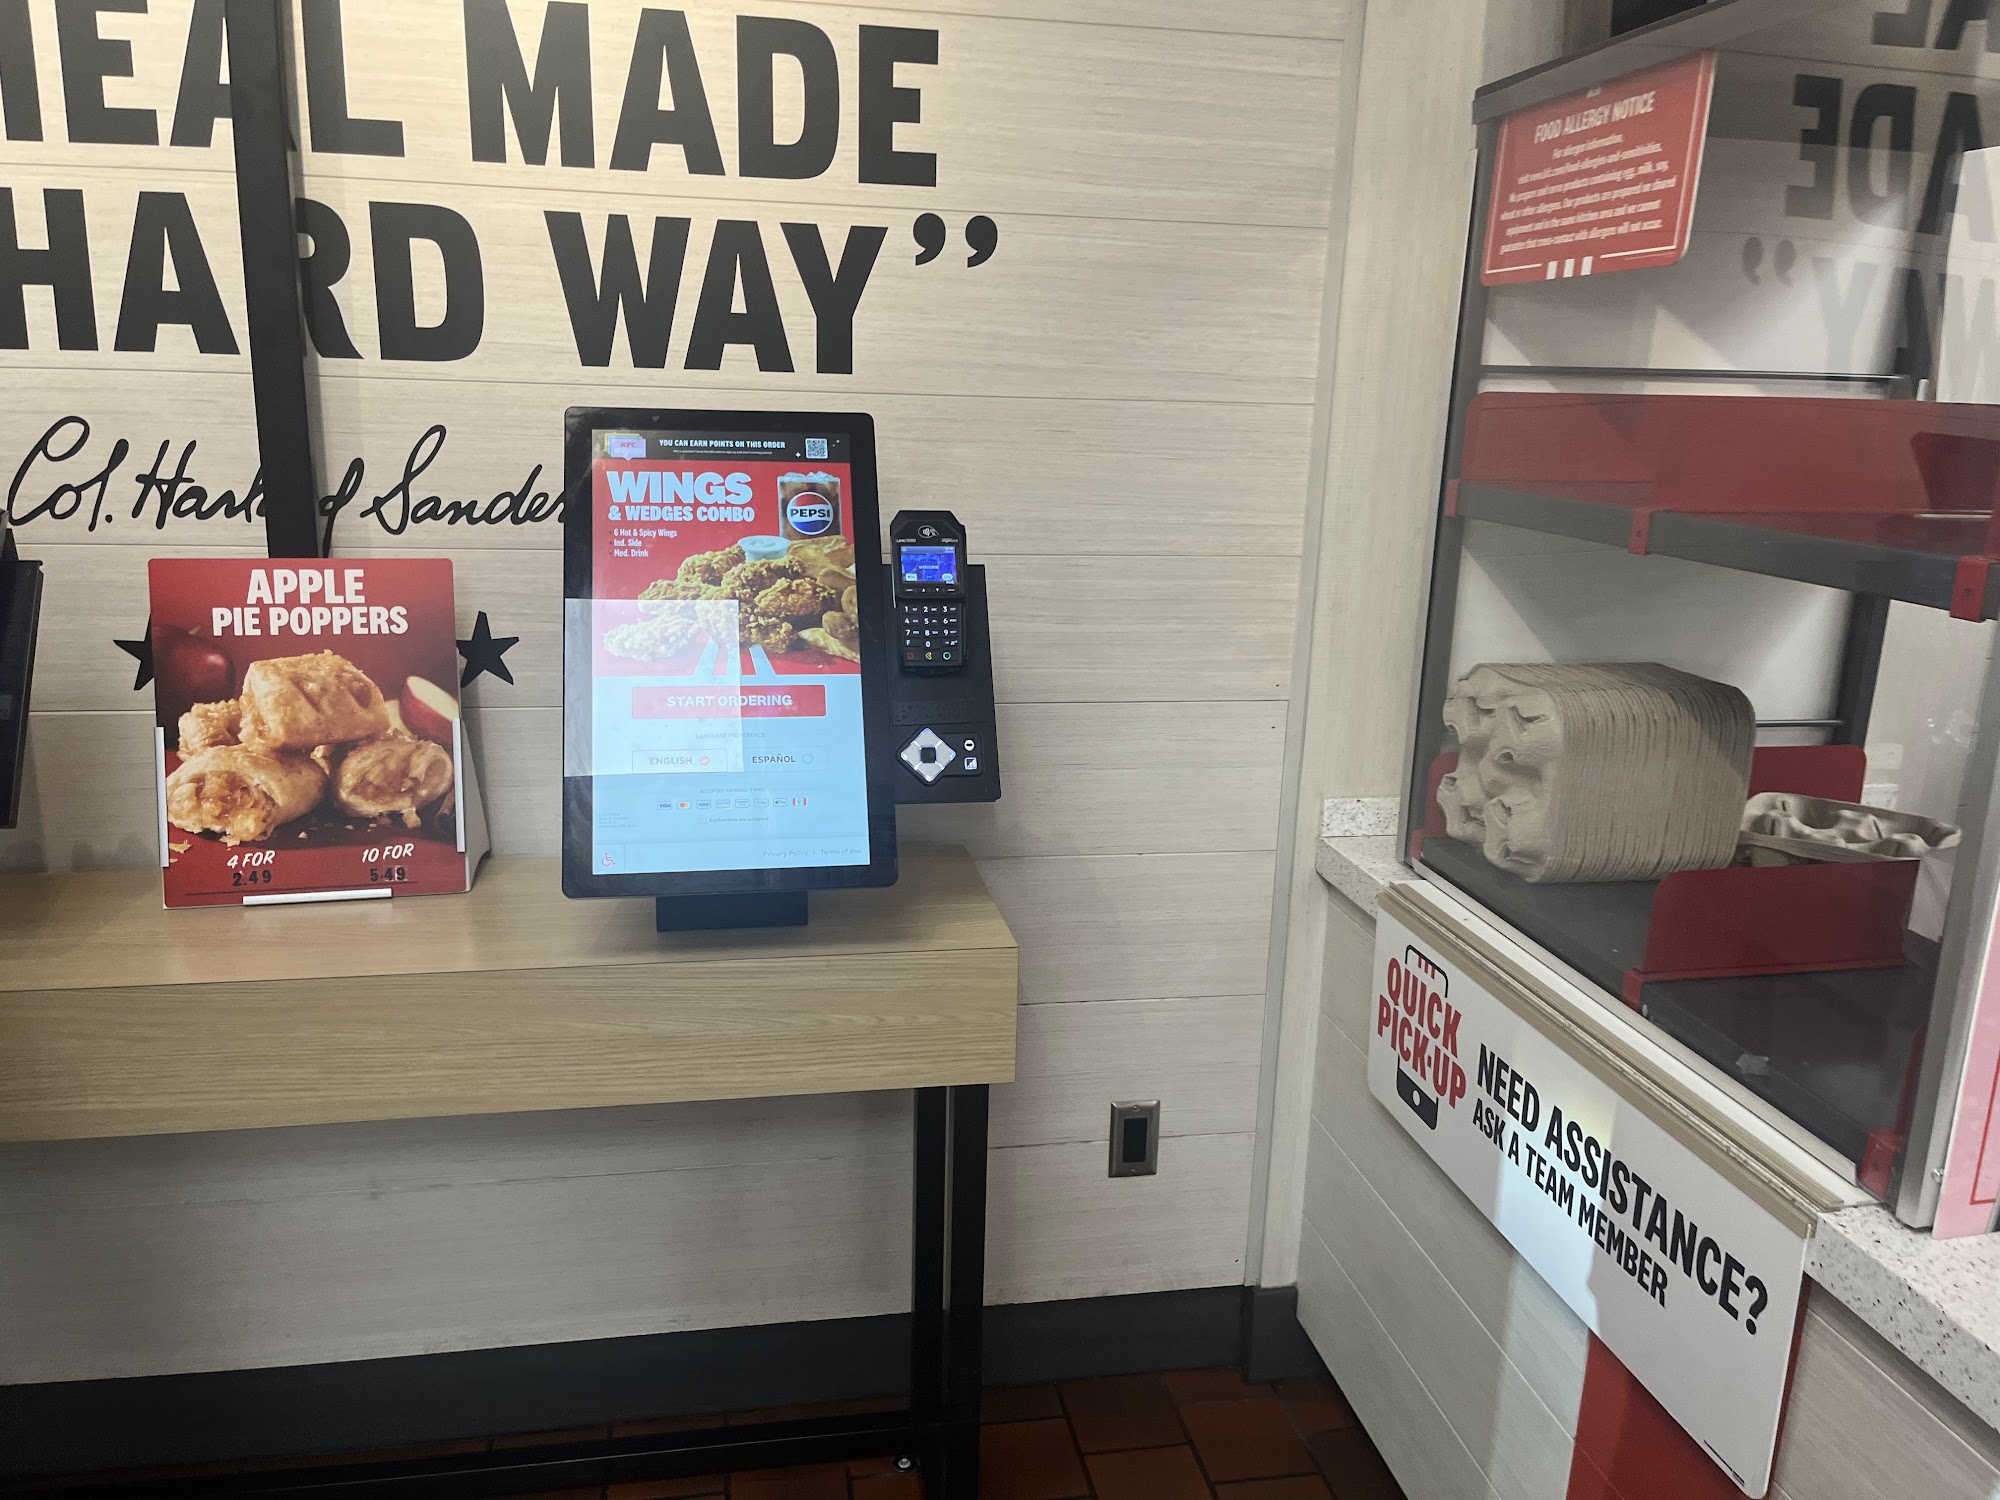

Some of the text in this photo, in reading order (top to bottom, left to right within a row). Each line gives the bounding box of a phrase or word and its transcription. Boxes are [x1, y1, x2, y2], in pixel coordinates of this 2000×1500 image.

[463, 0, 939, 187] MADE
[1534, 90, 1656, 144] FOOD ALLERGY NOTICE
[0, 187, 484, 362] HARD
[659, 439, 673, 447] YOU
[674, 439, 688, 447] CAN
[709, 440, 733, 448] POINTS
[735, 440, 745, 448] ON
[763, 441, 786, 449] ORDER
[7, 415, 564, 558] Col. Harld Sander
[606, 470, 753, 505] WINGS
[608, 505, 755, 522] & WEDGES COMBO
[790, 508, 831, 518] PEPSI
[613, 528, 677, 538] 6 Hot & Spicy Wings
[614, 538, 642, 547] Ind. Side
[614, 548, 649, 557] Med. Drink
[246, 568, 365, 604] APPLE
[212, 605, 409, 636] PIE POPPERS
[667, 694, 793, 707] START ORDERING
[650, 753, 796, 765] ENGLISH ESPAÑOL
[227, 850, 276, 869] 4 FOR
[362, 843, 415, 864] 10 FOR
[763, 850, 787, 858] Privacy
[1387, 957, 1462, 1059] QUICK
[1477, 1042, 1768, 1336] NEED ASSISTANCE?
[1473, 1097, 1668, 1309] ASK A TEAM MEMBER
